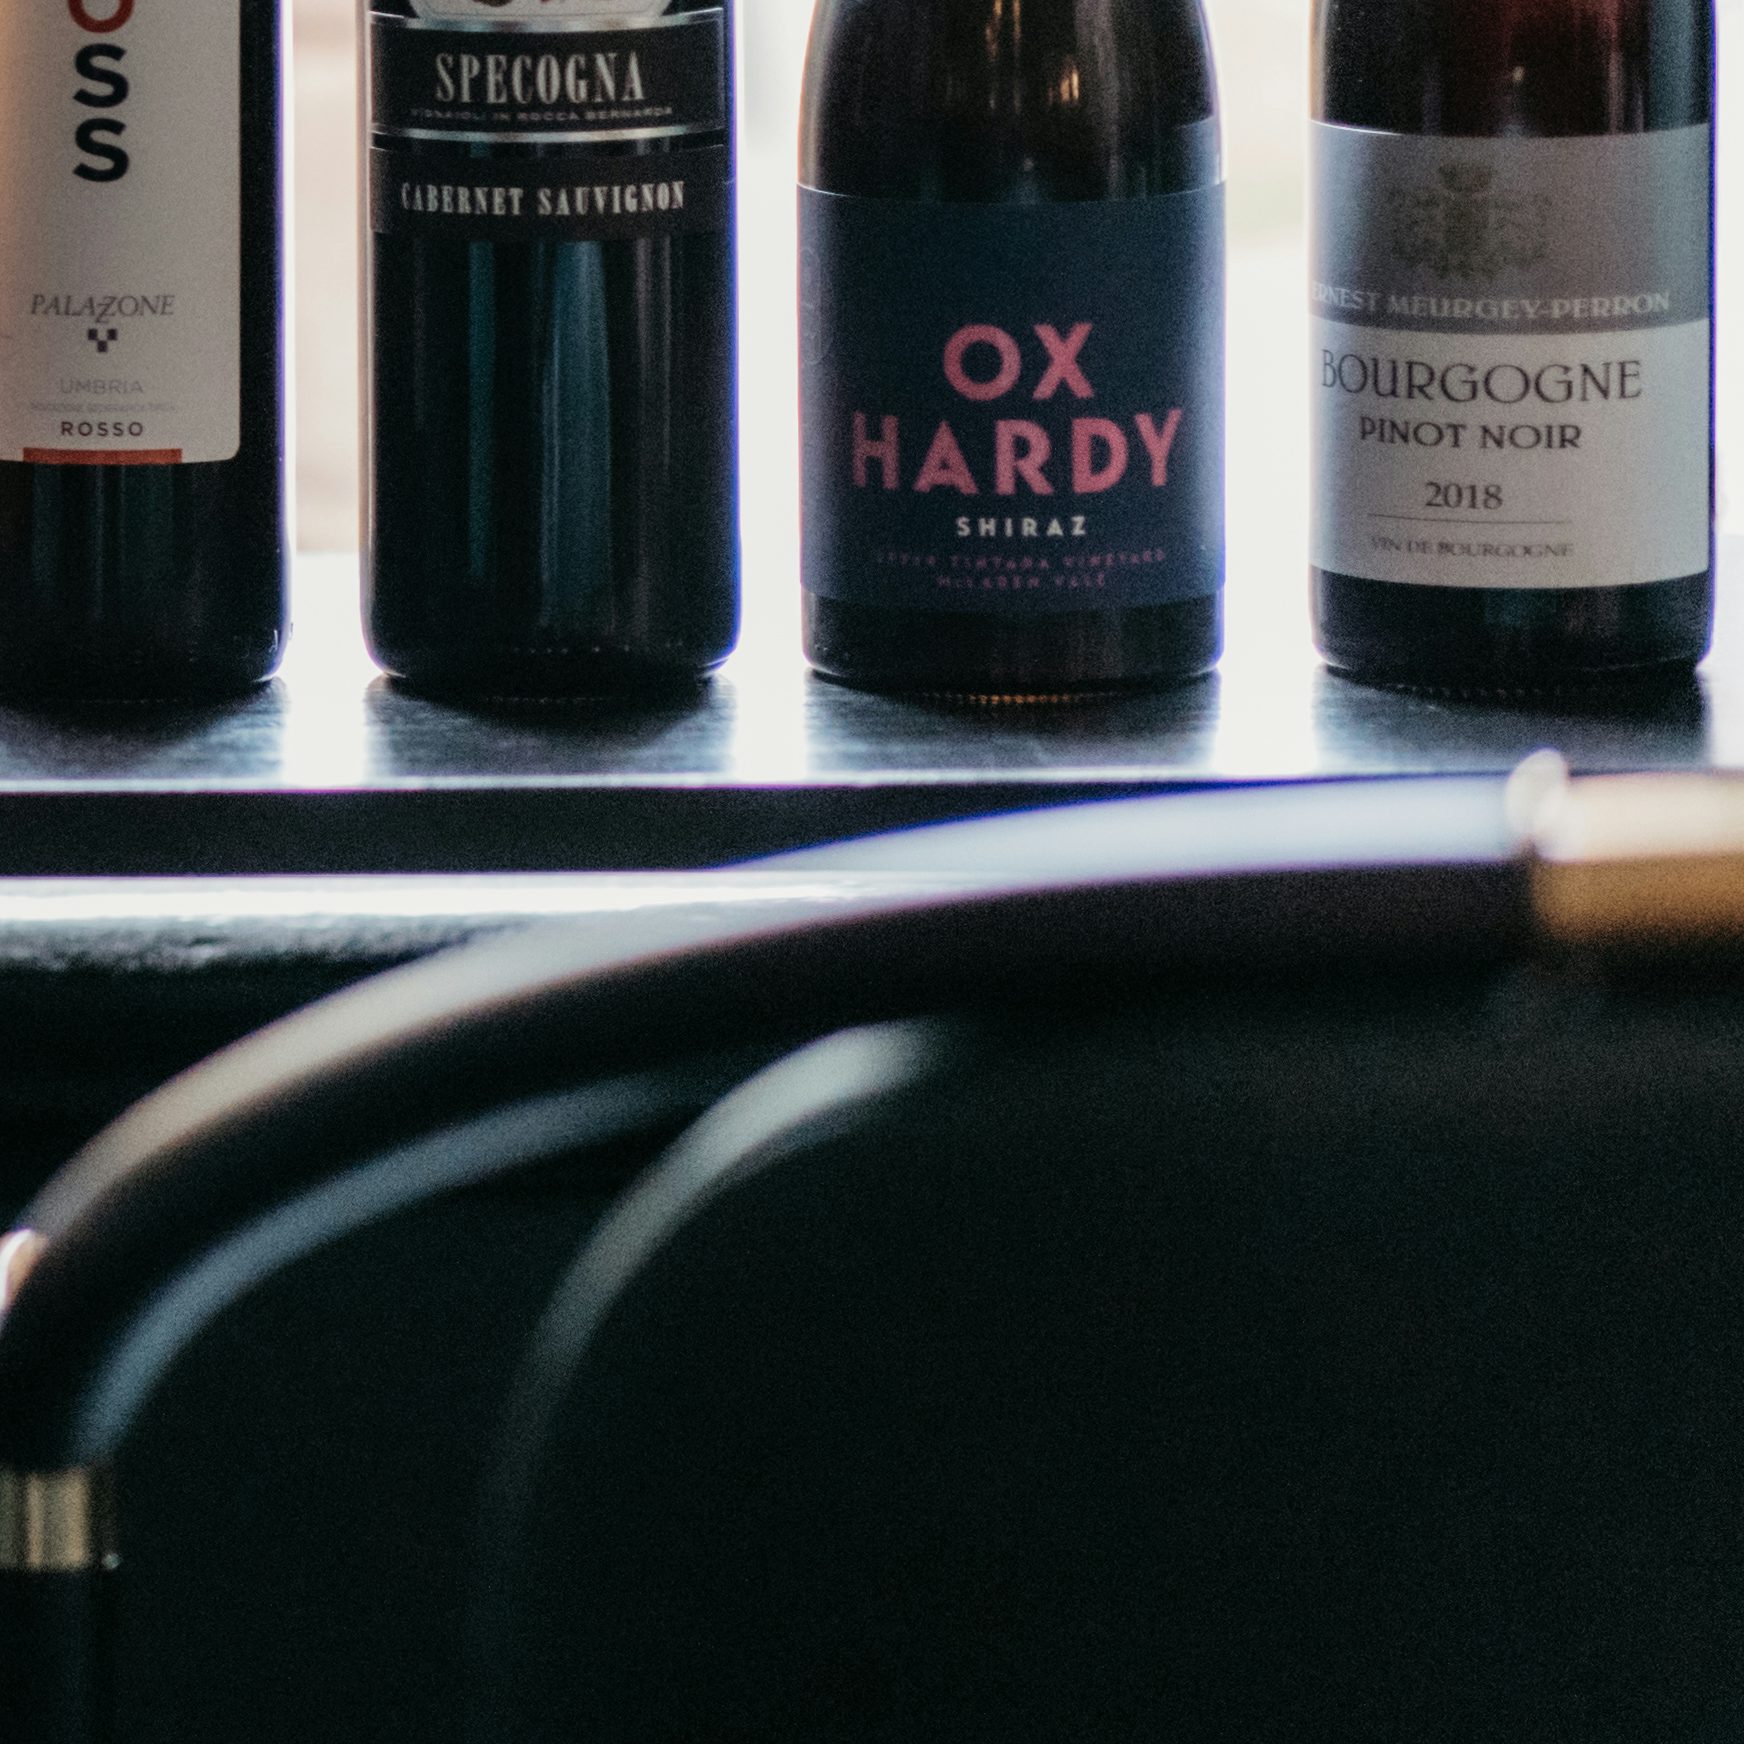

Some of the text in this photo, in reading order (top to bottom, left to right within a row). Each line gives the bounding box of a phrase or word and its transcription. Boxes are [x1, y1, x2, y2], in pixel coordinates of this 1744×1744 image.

[434, 50, 645, 105] SPECOGNA
[516, 111, 580, 122] ROCCA
[400, 180, 685, 216] CABERNET SAUVIGNON
[943, 321, 1095, 401] OX
[1321, 348, 1644, 405] BOURGOGNE
[58, 378, 145, 395] UMBRIA
[60, 420, 145, 437] ROSSO
[1358, 416, 1583, 449] PINOT NOIR
[850, 407, 1183, 495] HARDY
[1424, 481, 1504, 510] 2018
[955, 514, 1088, 538] SHIRAZ
[1436, 541, 1574, 558] BOURGOGNE
